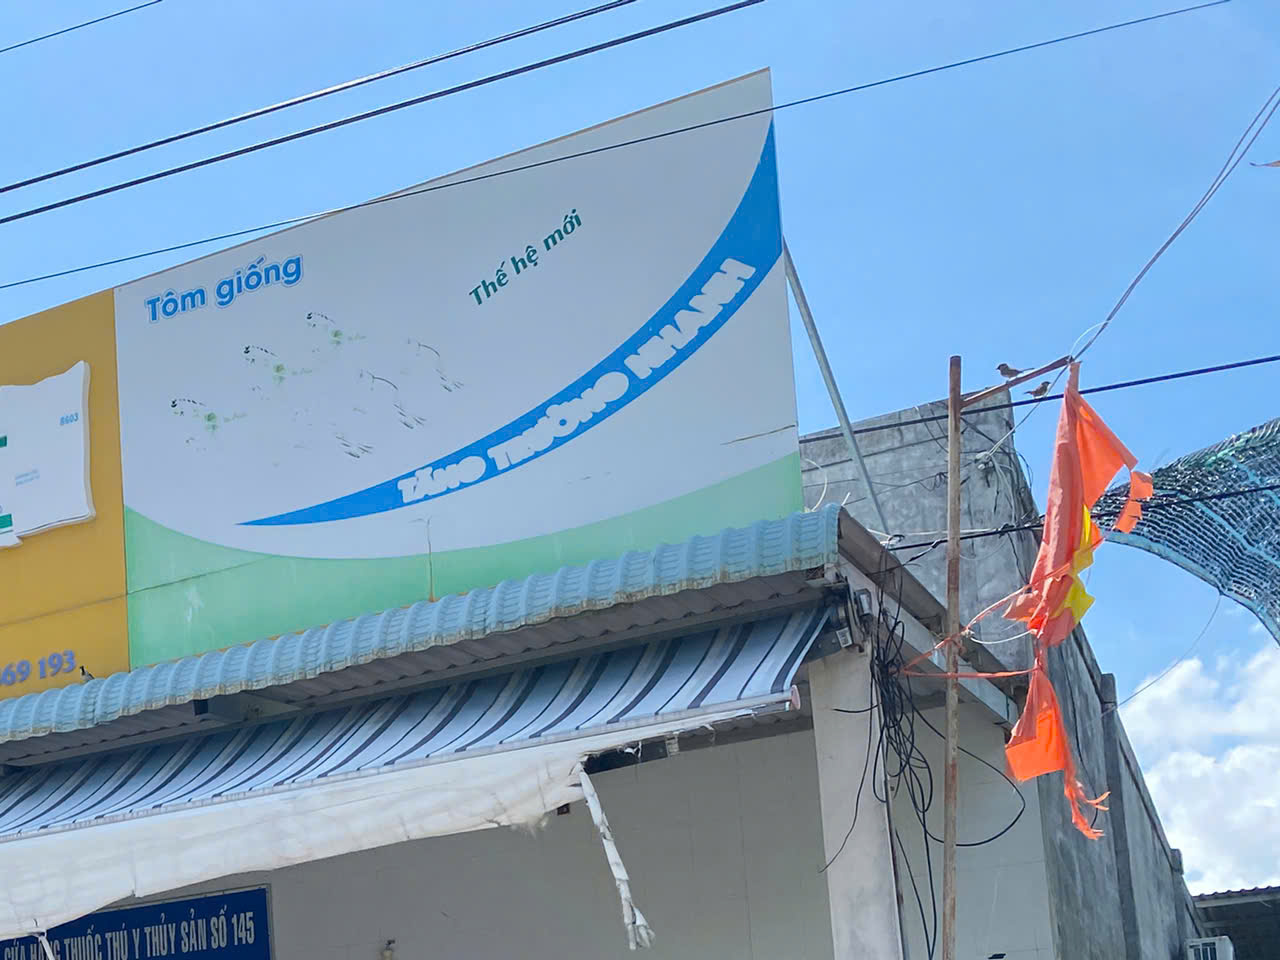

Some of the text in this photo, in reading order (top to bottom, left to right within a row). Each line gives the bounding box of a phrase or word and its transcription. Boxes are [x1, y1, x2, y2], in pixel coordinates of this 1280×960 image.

[469, 208, 582, 306] Thế hệ mới
[145, 255, 303, 322] Tôm giống
[38, 650, 77, 679] 193
[132, 931, 141, 959] Y
[144, 913, 176, 958] THỦY
[180, 908, 207, 953] SẢN
[210, 905, 228, 948] SỐ
[231, 911, 255, 946] 145
